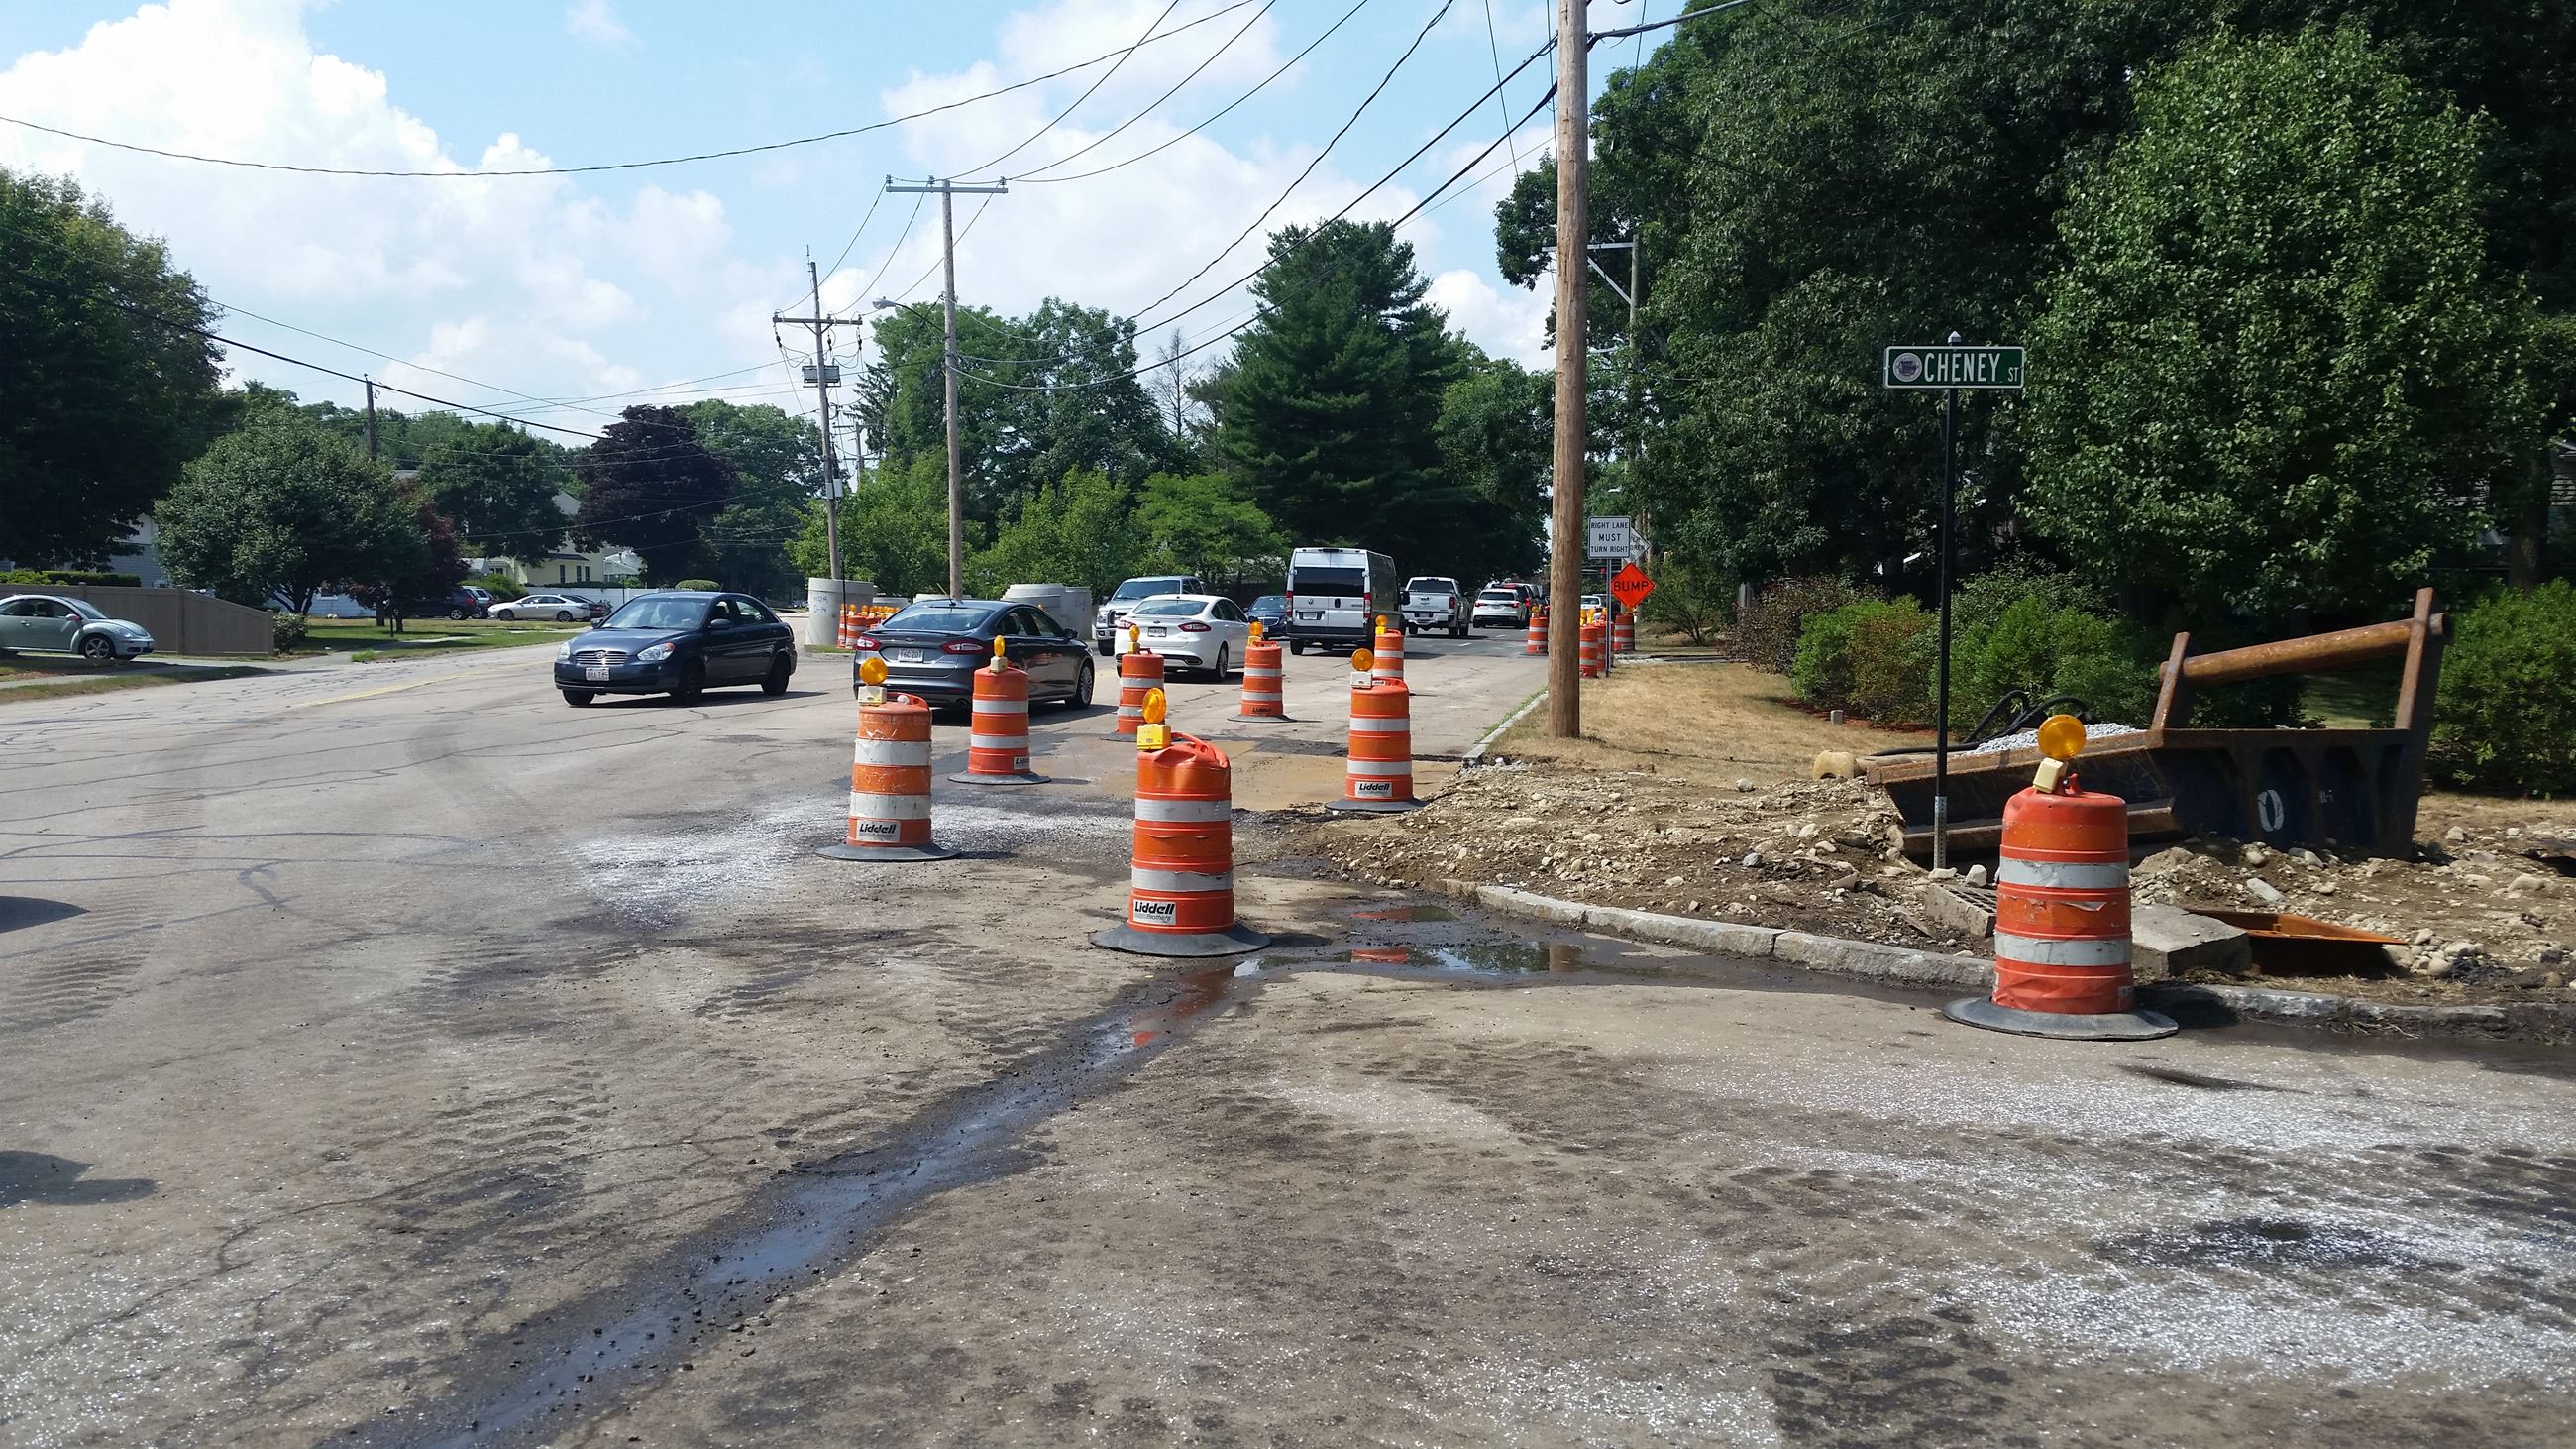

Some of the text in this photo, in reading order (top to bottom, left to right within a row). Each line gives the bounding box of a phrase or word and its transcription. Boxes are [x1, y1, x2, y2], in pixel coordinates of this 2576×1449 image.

[1924, 353, 2019, 383] CHENEY ST
[1598, 533, 1621, 542] MUST
[1613, 581, 1649, 592] BUMP
[859, 823, 897, 834] Liddell
[1134, 901, 1175, 915] Liddell
